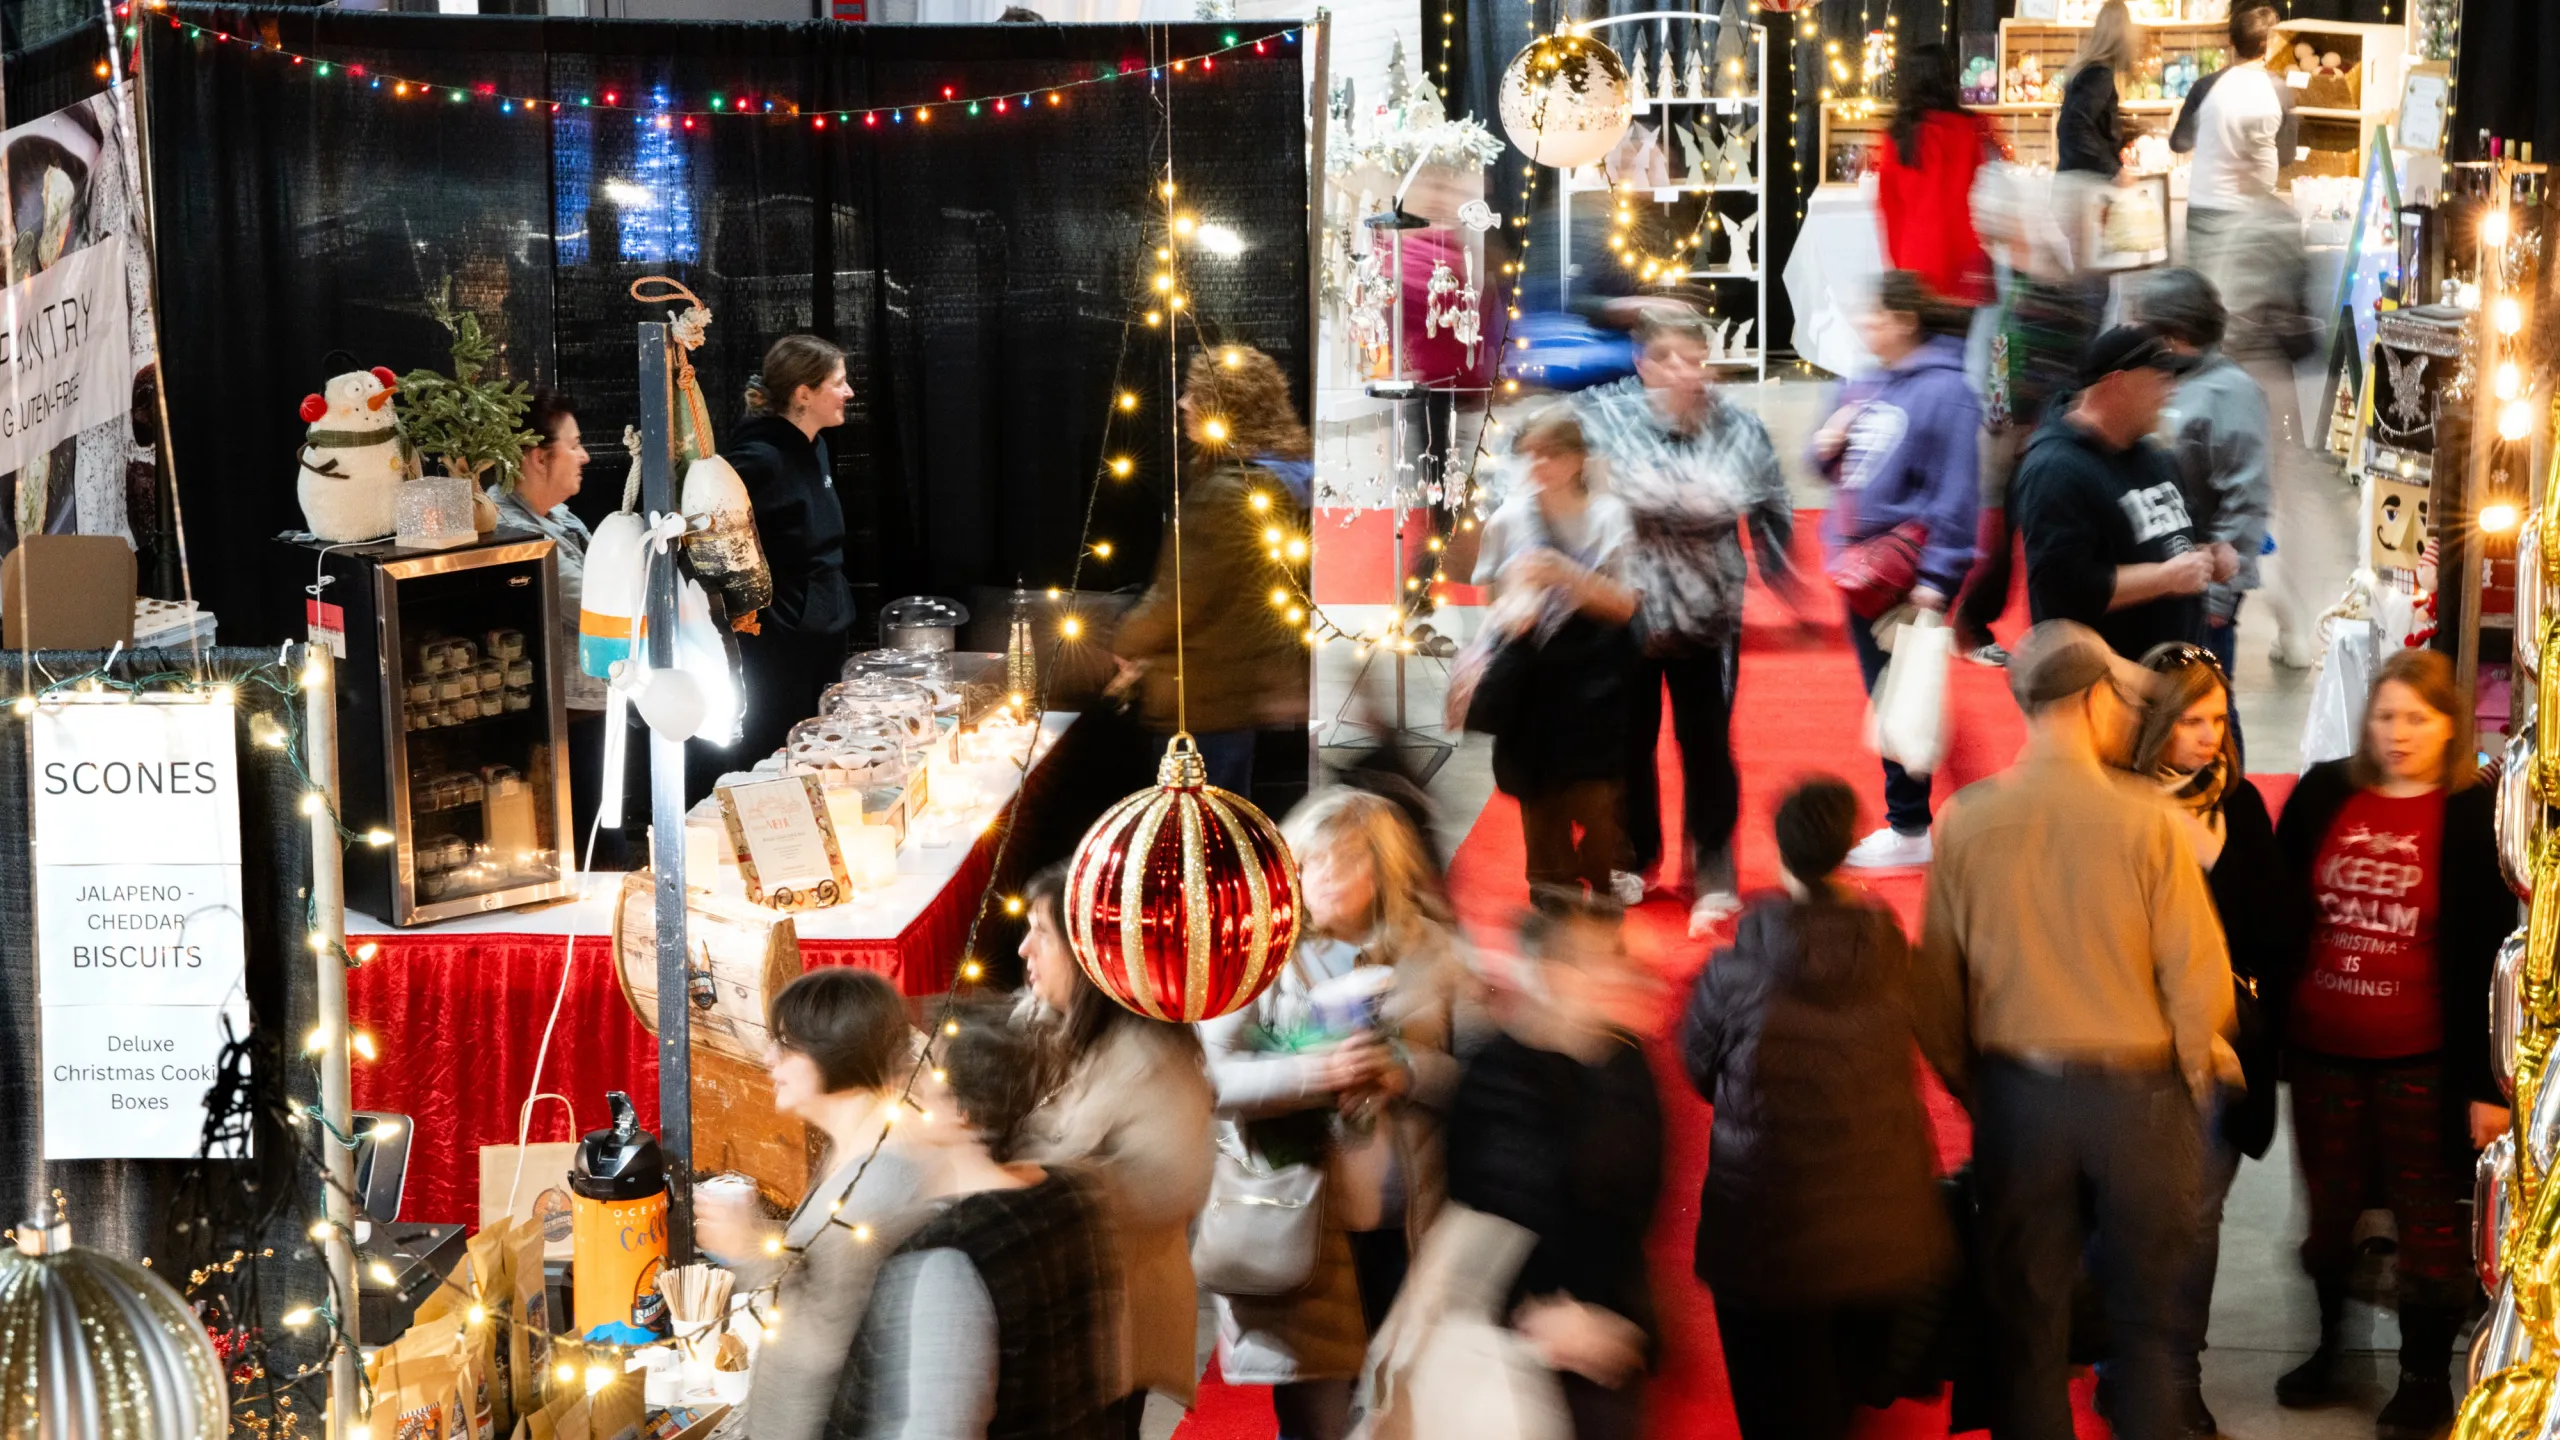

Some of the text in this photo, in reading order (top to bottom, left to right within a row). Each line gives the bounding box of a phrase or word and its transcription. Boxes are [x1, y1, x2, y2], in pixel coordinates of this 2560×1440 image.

[44, 761, 217, 795] SCONES
[2320, 853, 2424, 898] KEEP
[75, 885, 182, 902] JALAPENO
[87, 913, 185, 932] CHEDDAR
[2317, 892, 2420, 938] CALM
[73, 945, 203, 969] BISCUITS
[108, 1035, 175, 1052] Deluxe
[53, 1064, 216, 1082] Christmas Cooki
[111, 1093, 169, 1110] Boxes
